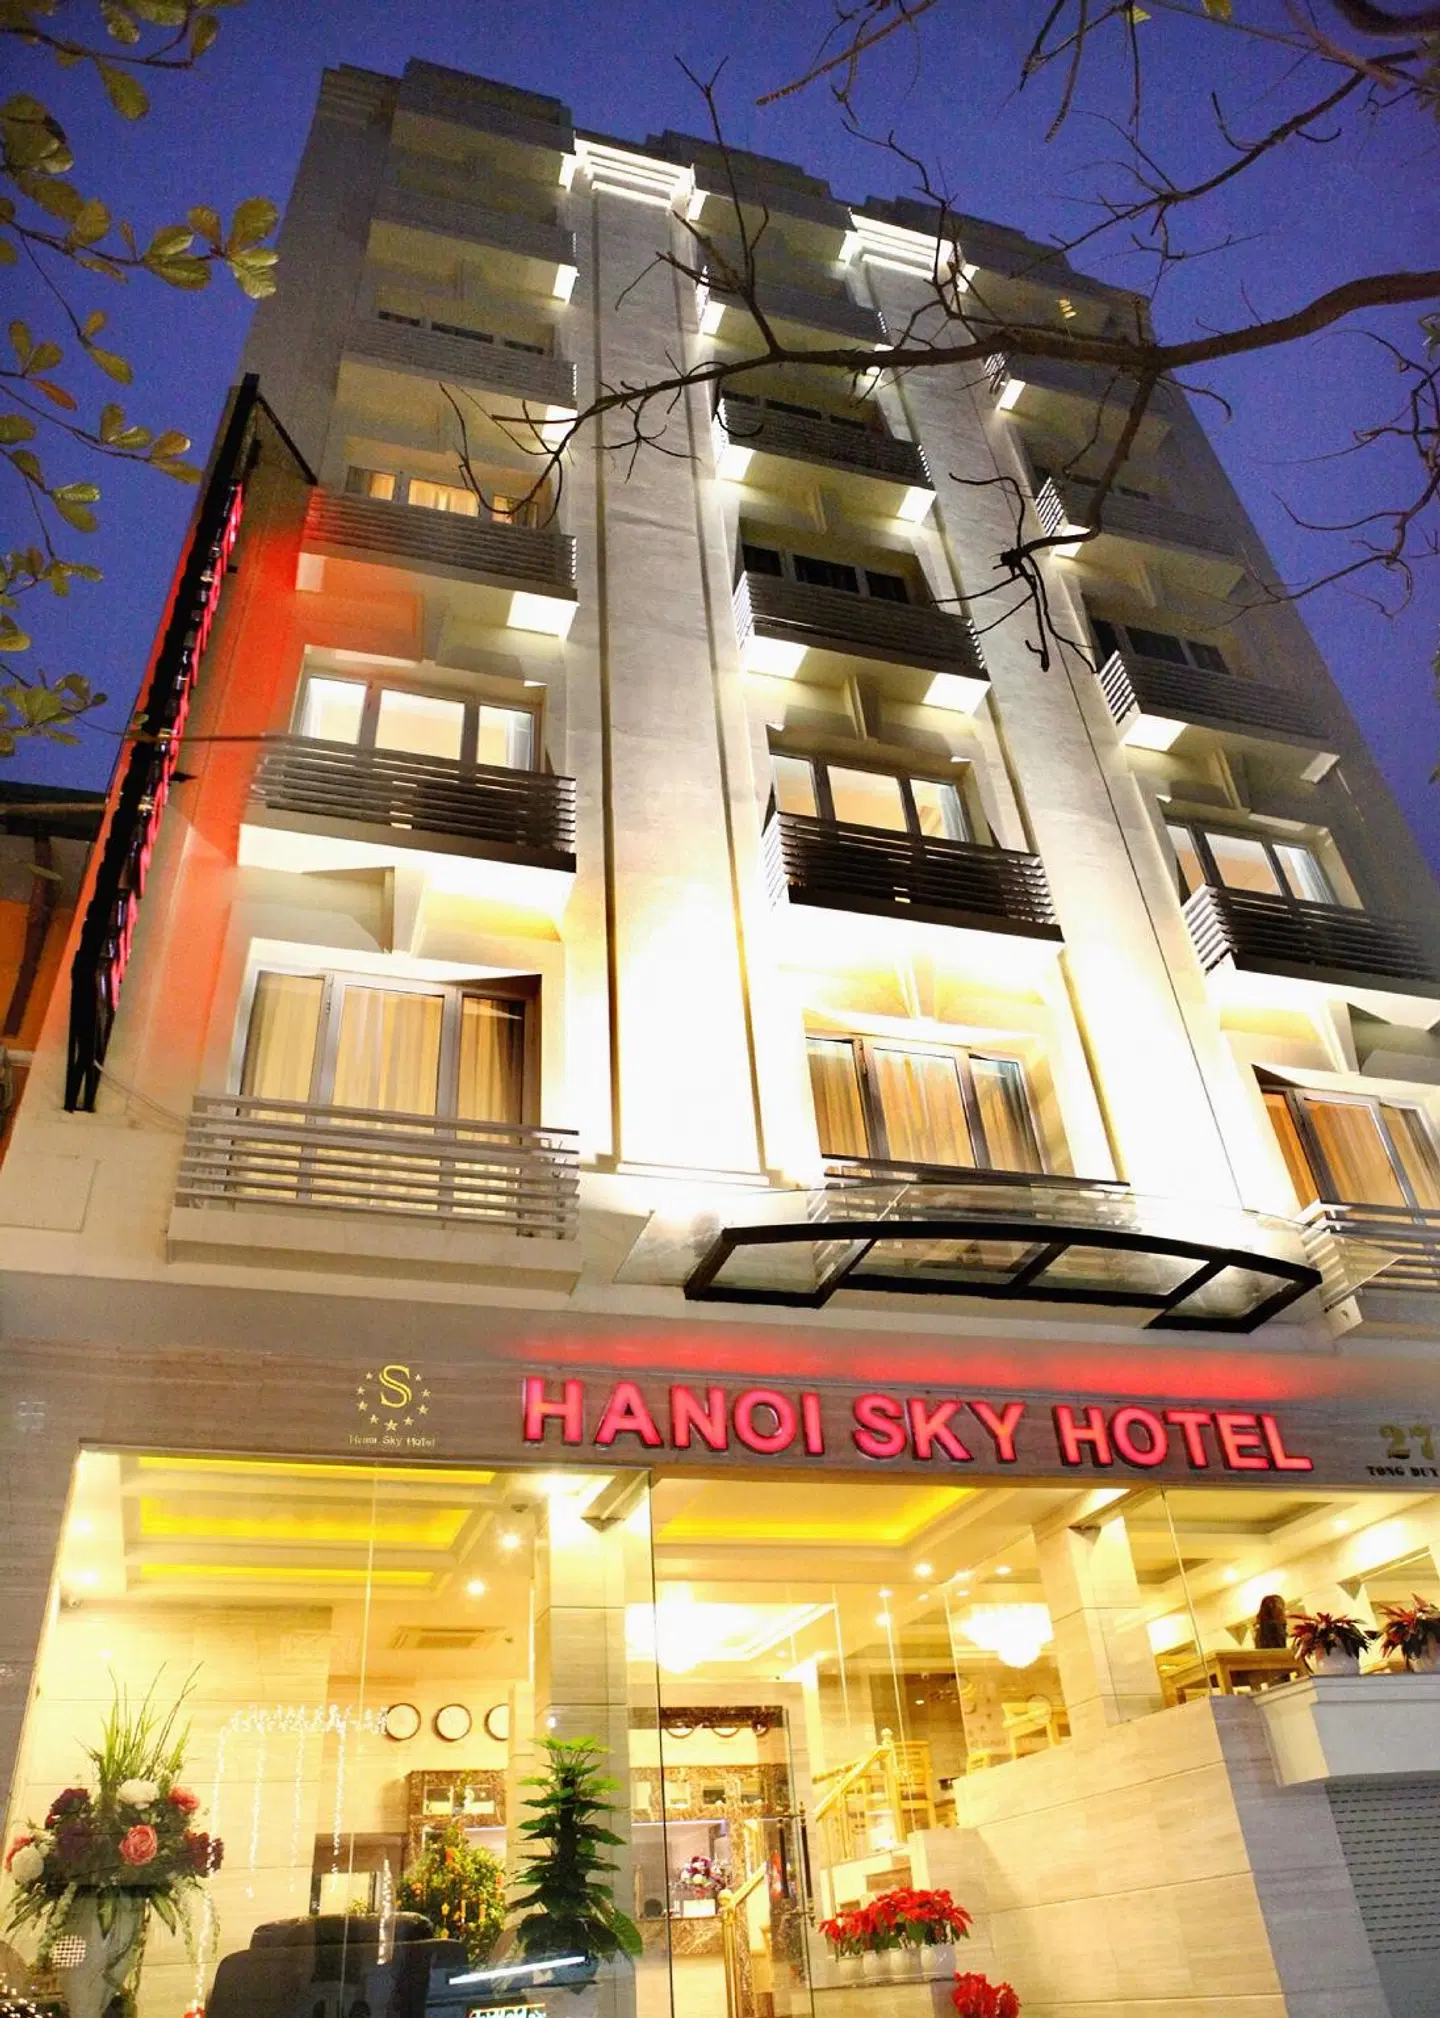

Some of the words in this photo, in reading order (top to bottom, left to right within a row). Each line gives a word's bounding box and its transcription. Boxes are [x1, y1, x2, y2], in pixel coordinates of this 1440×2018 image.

[382, 1434, 403, 1449] Sky
[523, 1376, 825, 1457] HANOI
[853, 1393, 1025, 1463] SKY
[1053, 1403, 1314, 1472] HOTEL
[1378, 1425, 1436, 1461] 27
